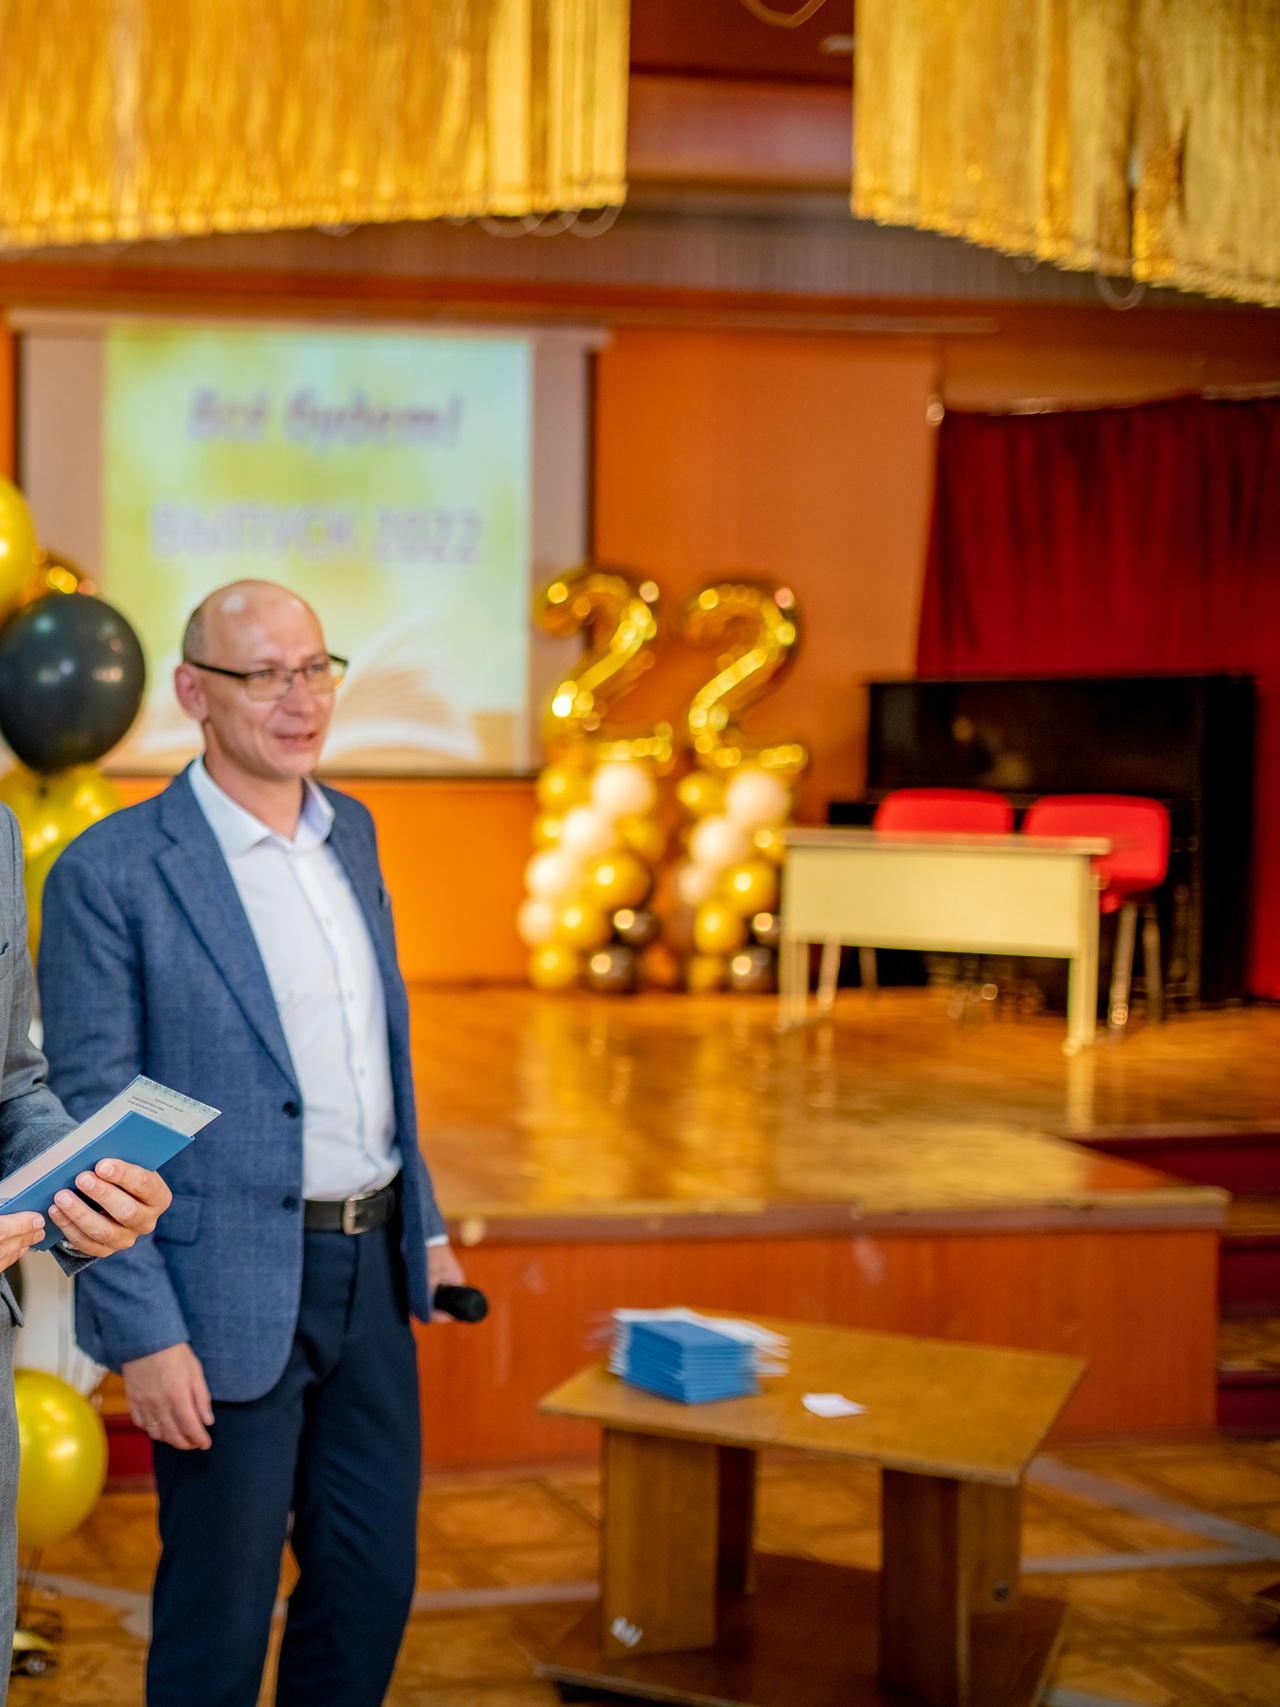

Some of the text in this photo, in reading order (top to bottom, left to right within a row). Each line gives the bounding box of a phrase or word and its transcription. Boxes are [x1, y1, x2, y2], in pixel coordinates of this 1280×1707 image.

[284, 386, 465, 452] будет!
[151, 505, 483, 564] ВЫПУСК 2022
